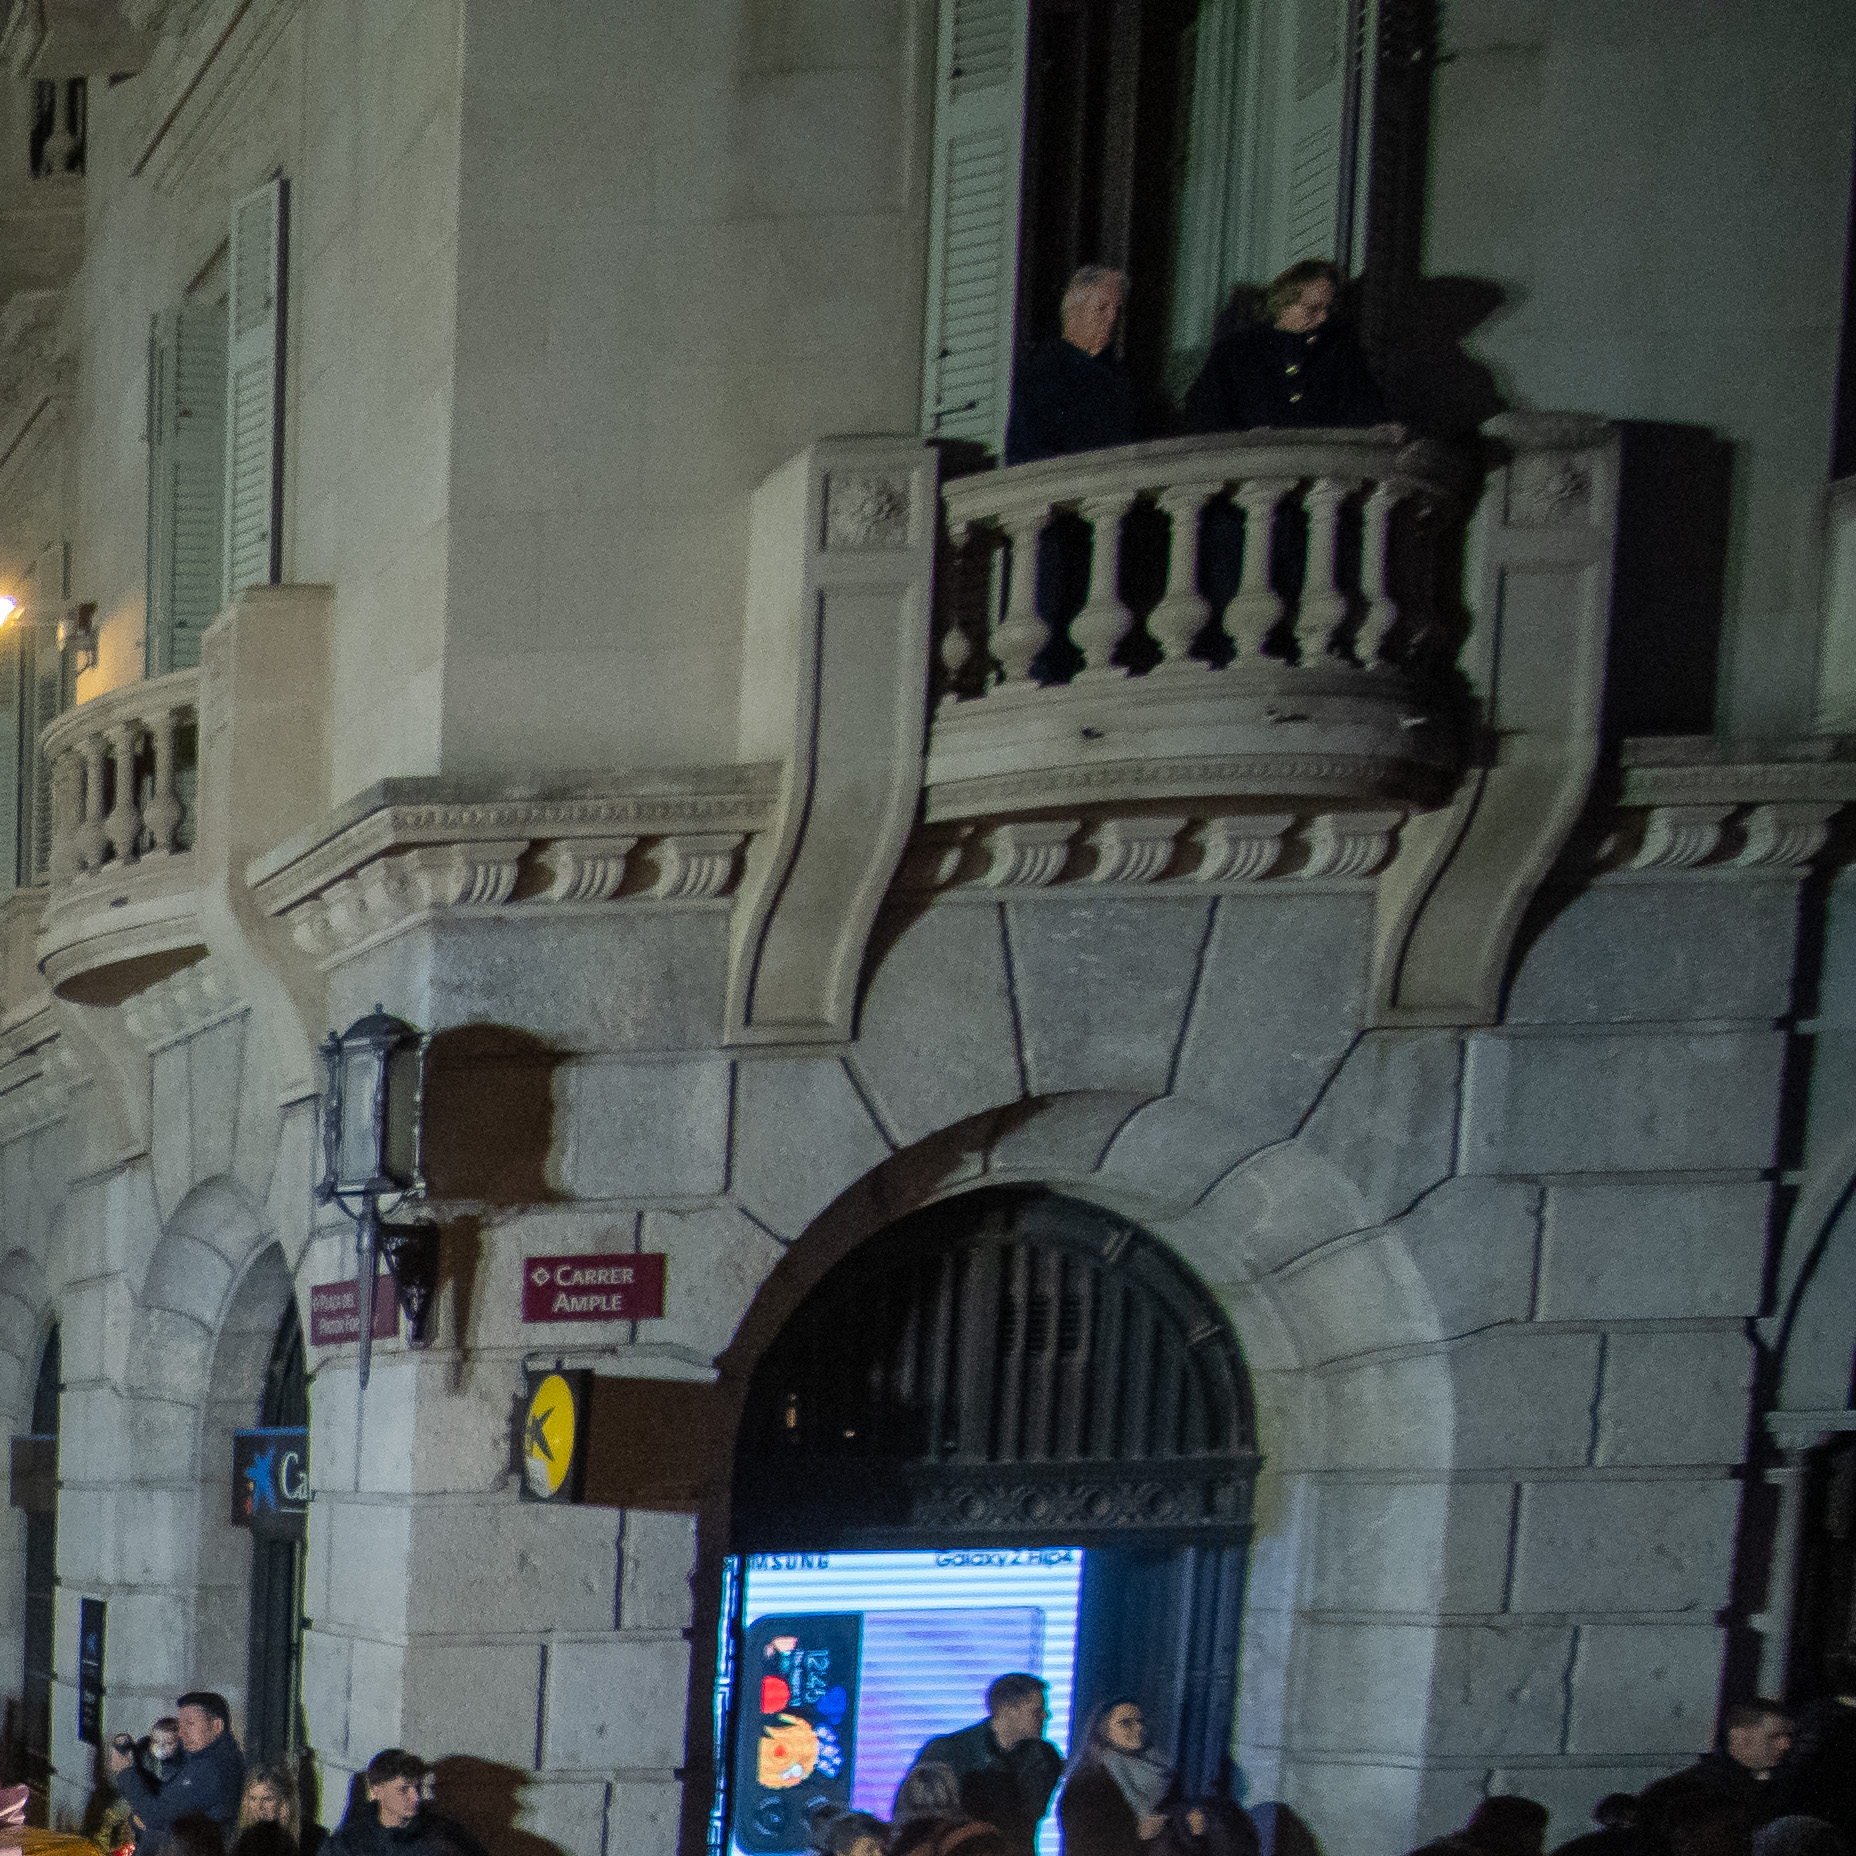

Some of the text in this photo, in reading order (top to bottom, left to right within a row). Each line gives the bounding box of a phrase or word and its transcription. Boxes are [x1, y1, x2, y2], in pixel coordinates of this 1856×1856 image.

[553, 1264, 634, 1286] CARRER
[553, 1293, 622, 1313] AMPLE
[935, 1551, 1006, 1568] Galaxy
